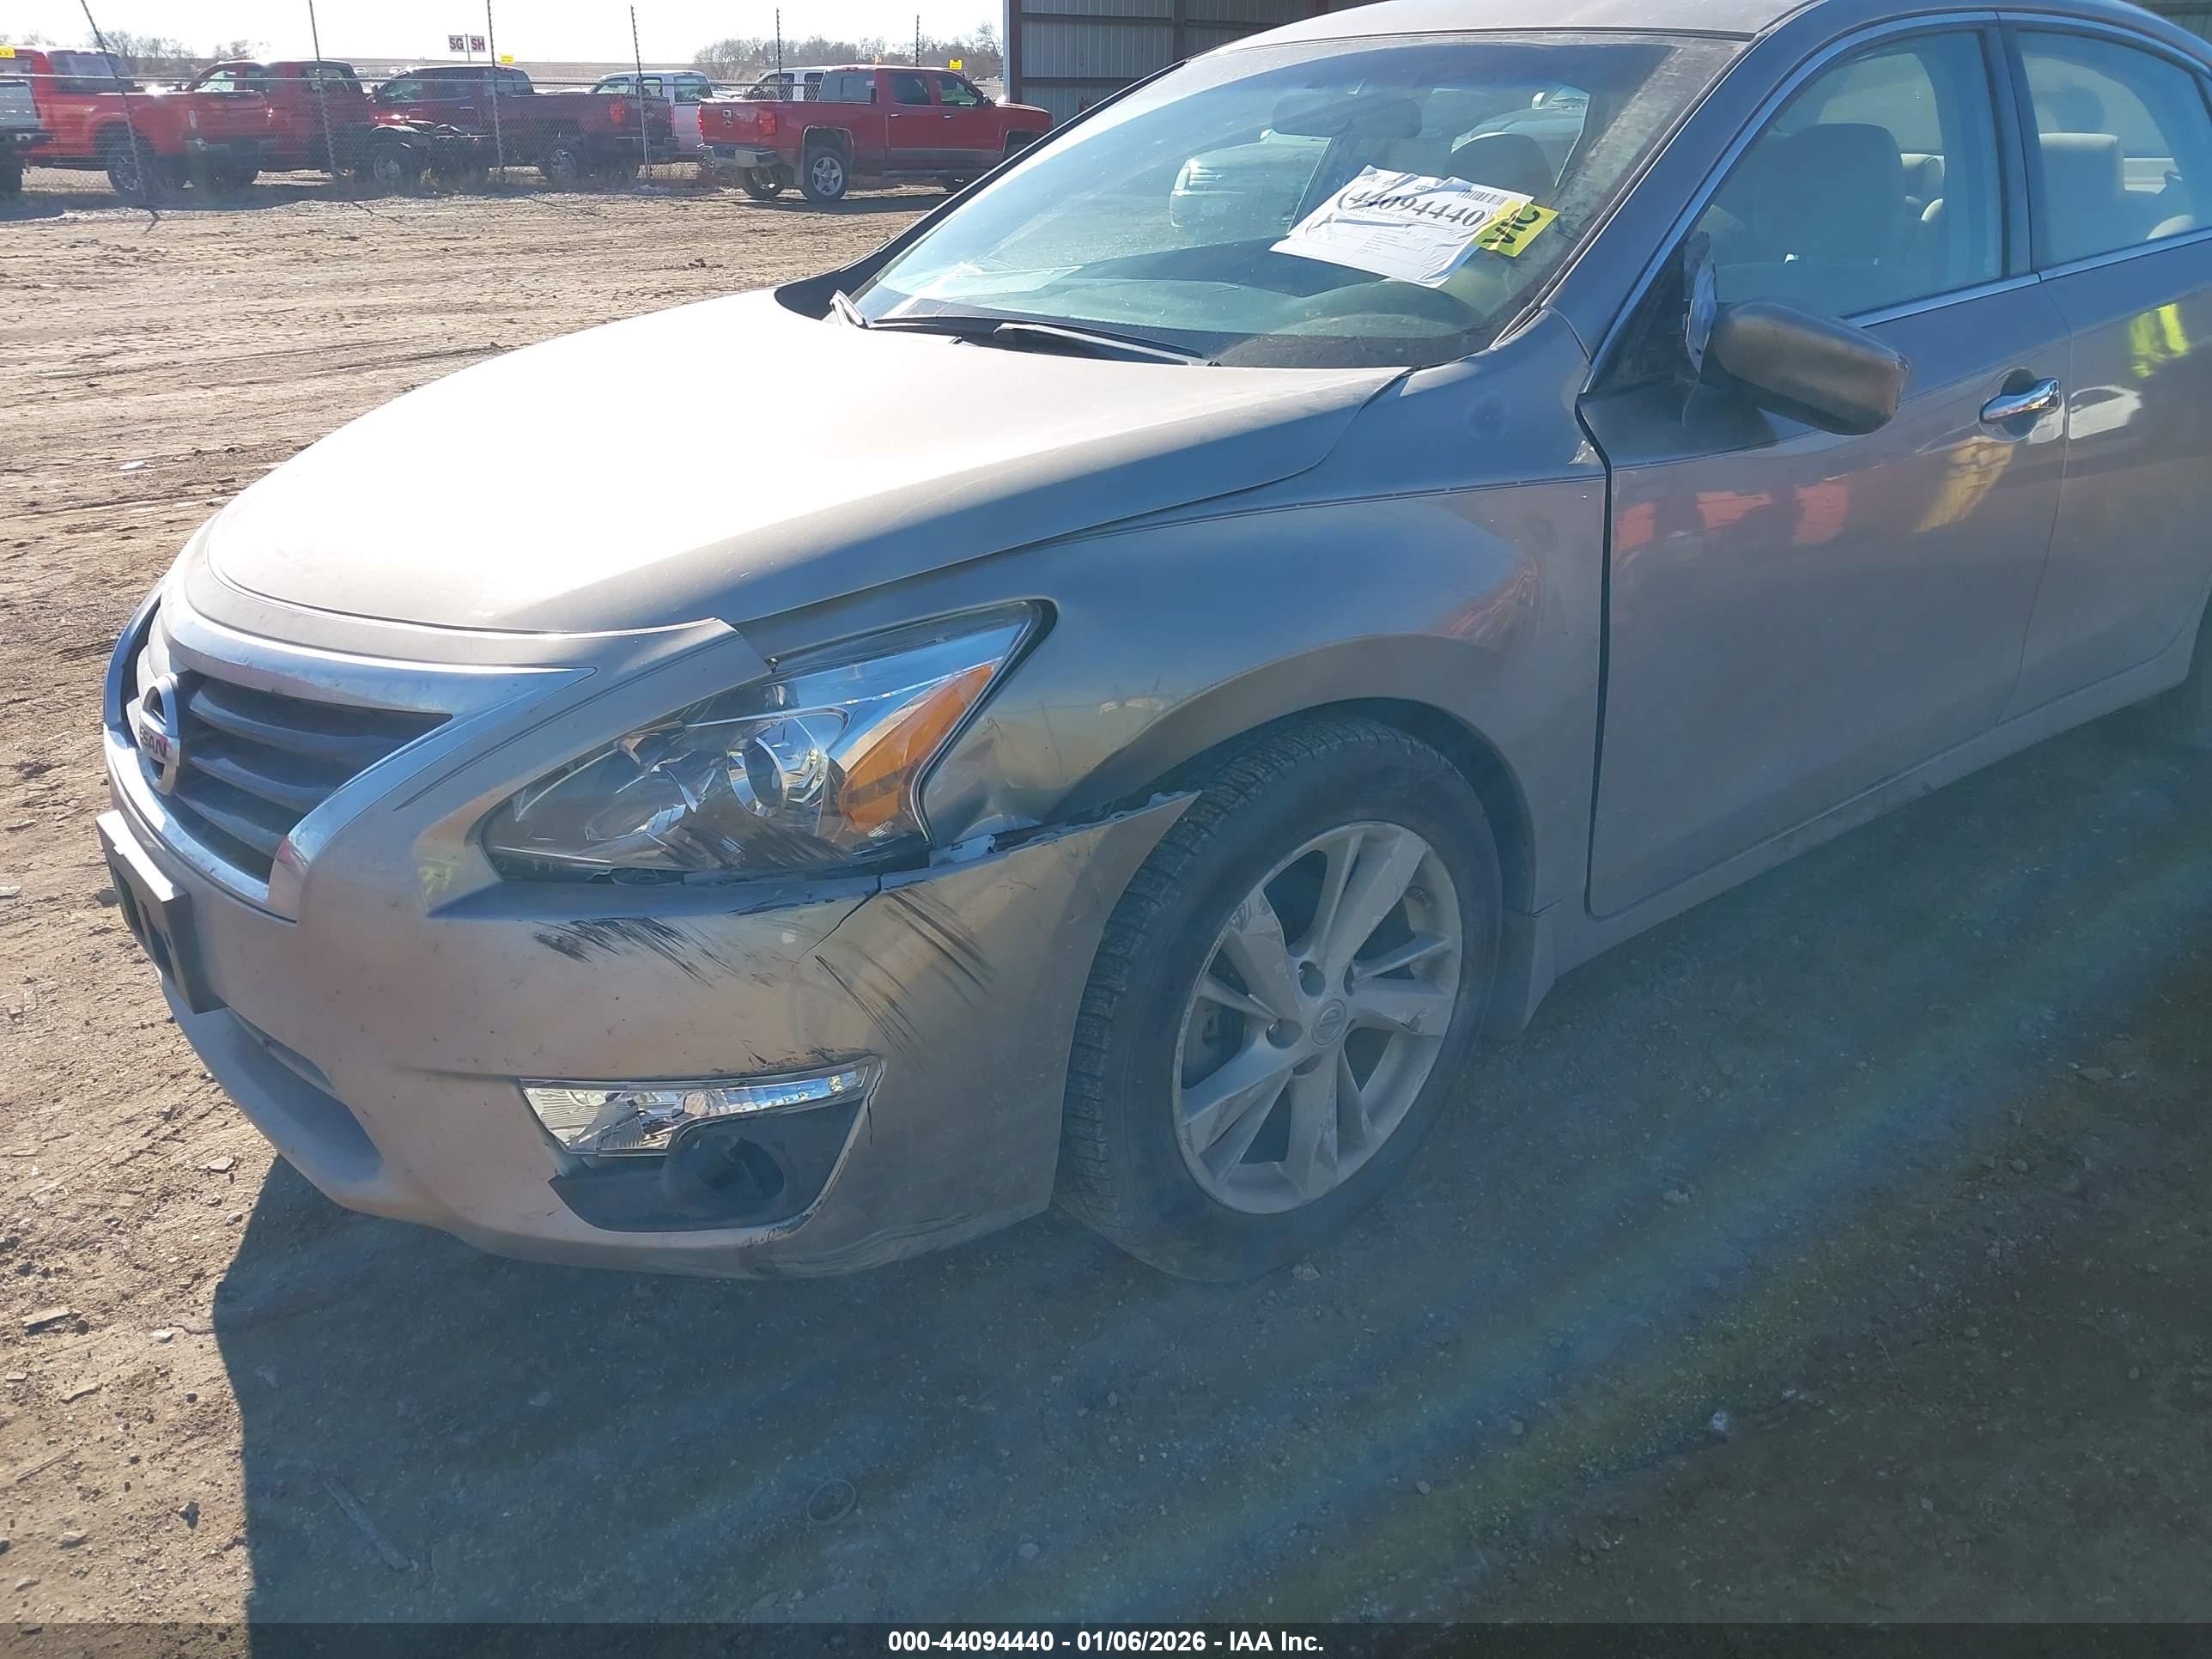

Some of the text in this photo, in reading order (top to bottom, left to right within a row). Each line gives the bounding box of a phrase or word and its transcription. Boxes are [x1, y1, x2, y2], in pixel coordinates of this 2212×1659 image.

[449, 37, 465, 50] SG
[471, 38, 486, 51] SH
[1348, 191, 1486, 227] 44094440
